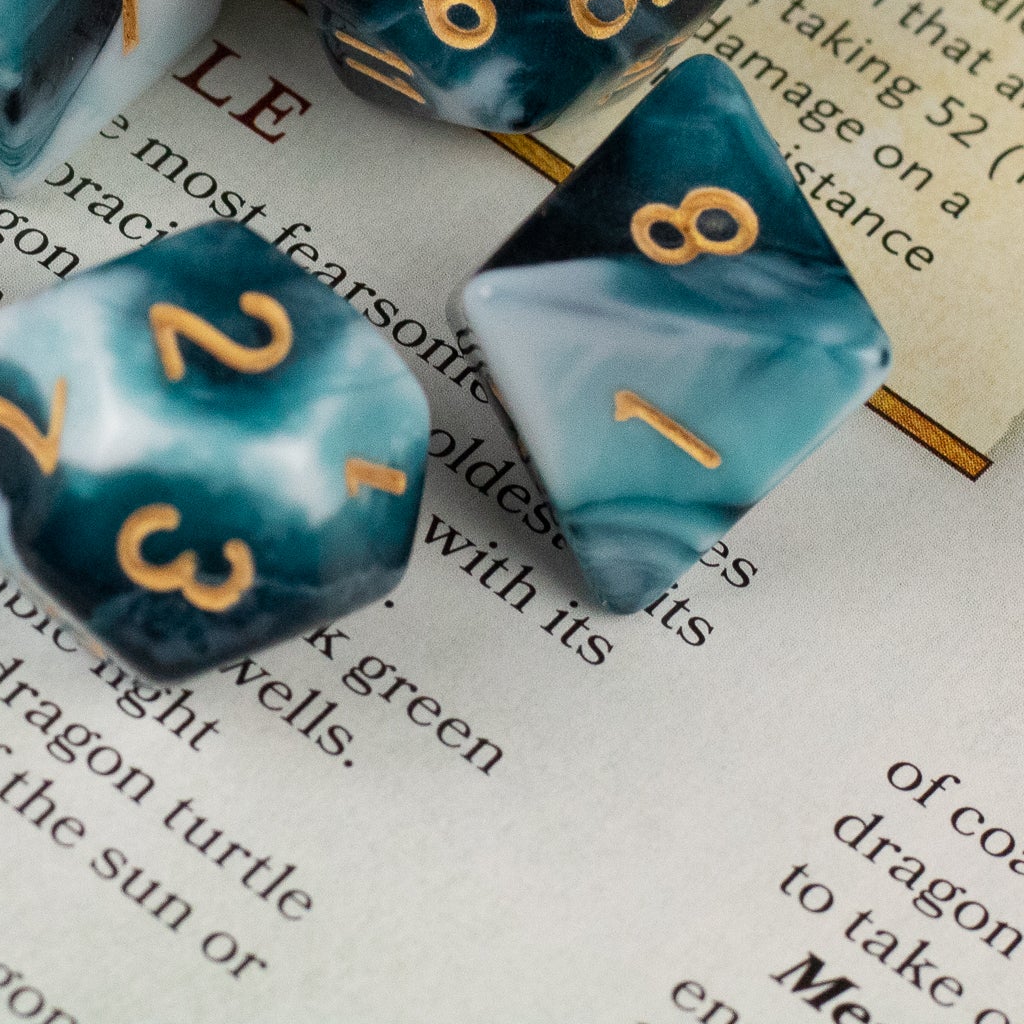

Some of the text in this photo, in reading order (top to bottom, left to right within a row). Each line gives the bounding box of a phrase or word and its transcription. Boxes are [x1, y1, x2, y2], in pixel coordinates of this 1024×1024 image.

[898, 1, 994, 77] that
[694, 14, 866, 144] damage
[873, 140, 936, 193] on
[939, 189, 973, 221] a
[924, 94, 989, 149] 52
[130, 136, 268, 227] most
[630, 184, 760, 266] 8
[149, 290, 294, 382] 2
[613, 390, 722, 470] 1
[345, 457, 408, 497] 1
[115, 502, 256, 613] 3
[424, 513, 538, 615] with
[540, 600, 615, 666] its
[644, 582, 714, 648] its
[343, 655, 505, 777] green
[886, 760, 962, 809] of
[162, 797, 314, 923] turtle
[833, 813, 1024, 961] dragon
[89, 845, 195, 934] sun
[199, 929, 269, 980] or
[780, 862, 965, 1009] to take
